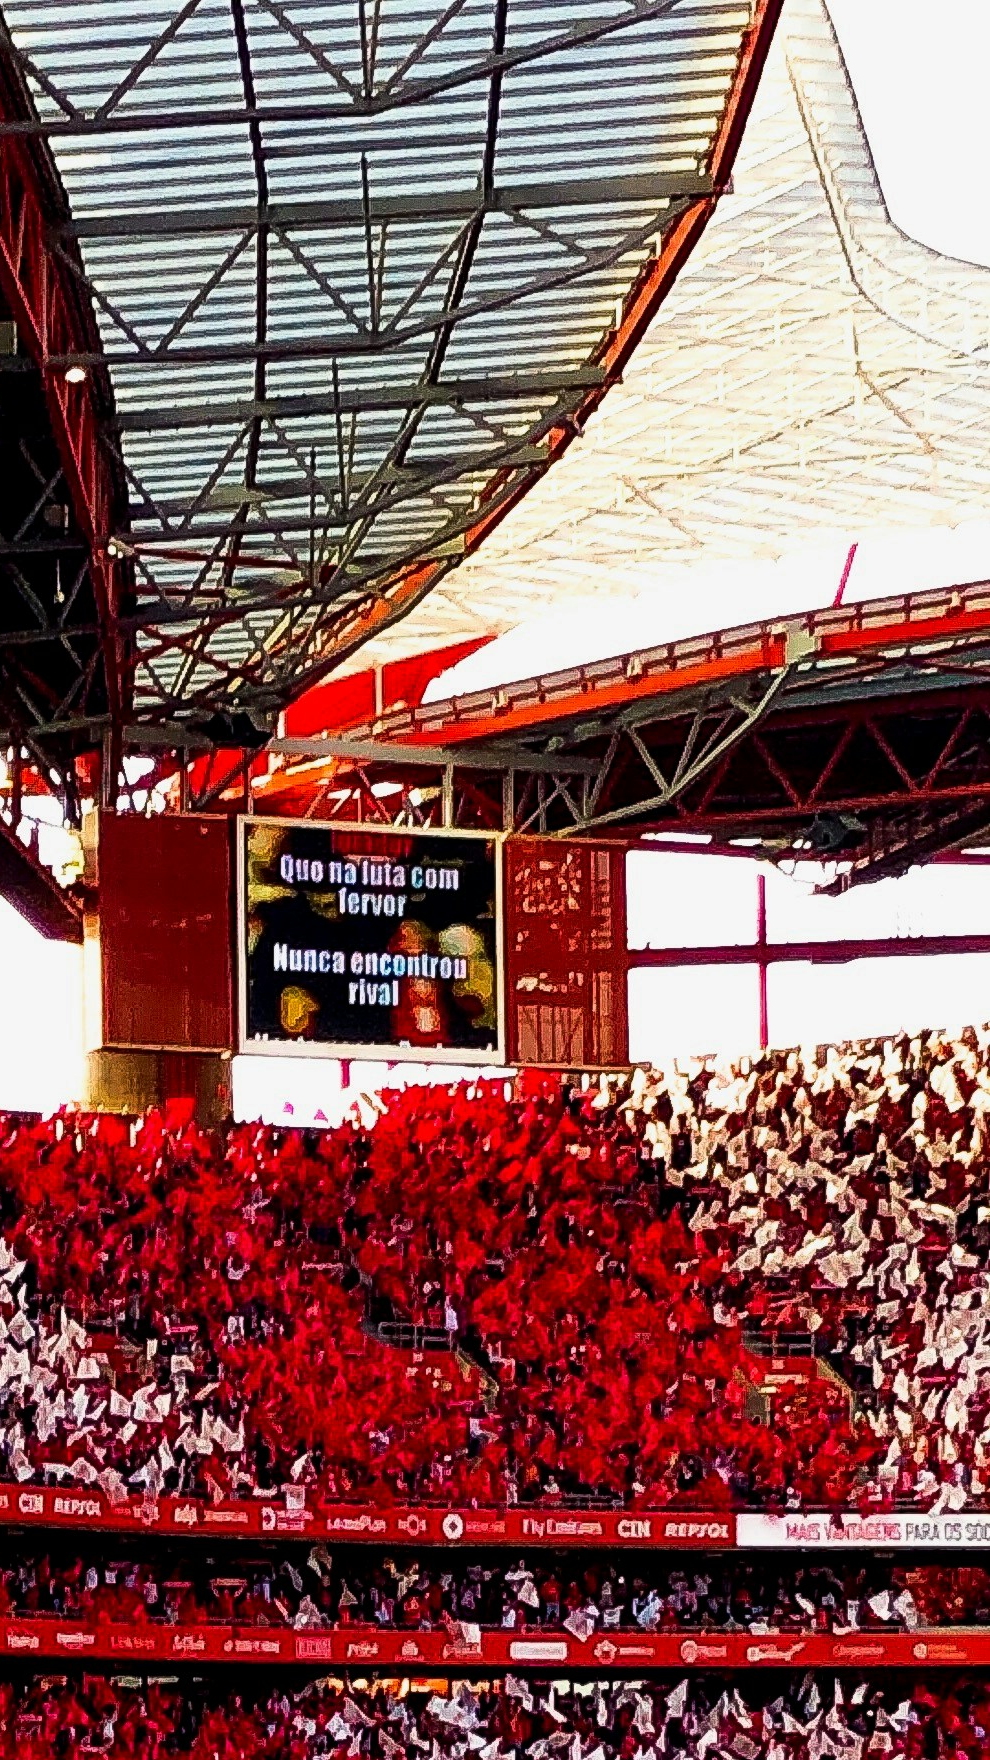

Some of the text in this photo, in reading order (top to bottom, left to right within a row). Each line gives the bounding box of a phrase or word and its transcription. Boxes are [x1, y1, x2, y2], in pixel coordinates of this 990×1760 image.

[329, 860, 357, 885] na
[362, 860, 406, 888] luta
[411, 866, 459, 890] com
[339, 887, 407, 917] fervor
[273, 942, 467, 979] Nunca encontrou
[348, 978, 399, 1006] rival
[617, 1519, 651, 1538] CIN
[664, 1522, 729, 1538] REPSOL
[906, 1522, 940, 1541] PARA
